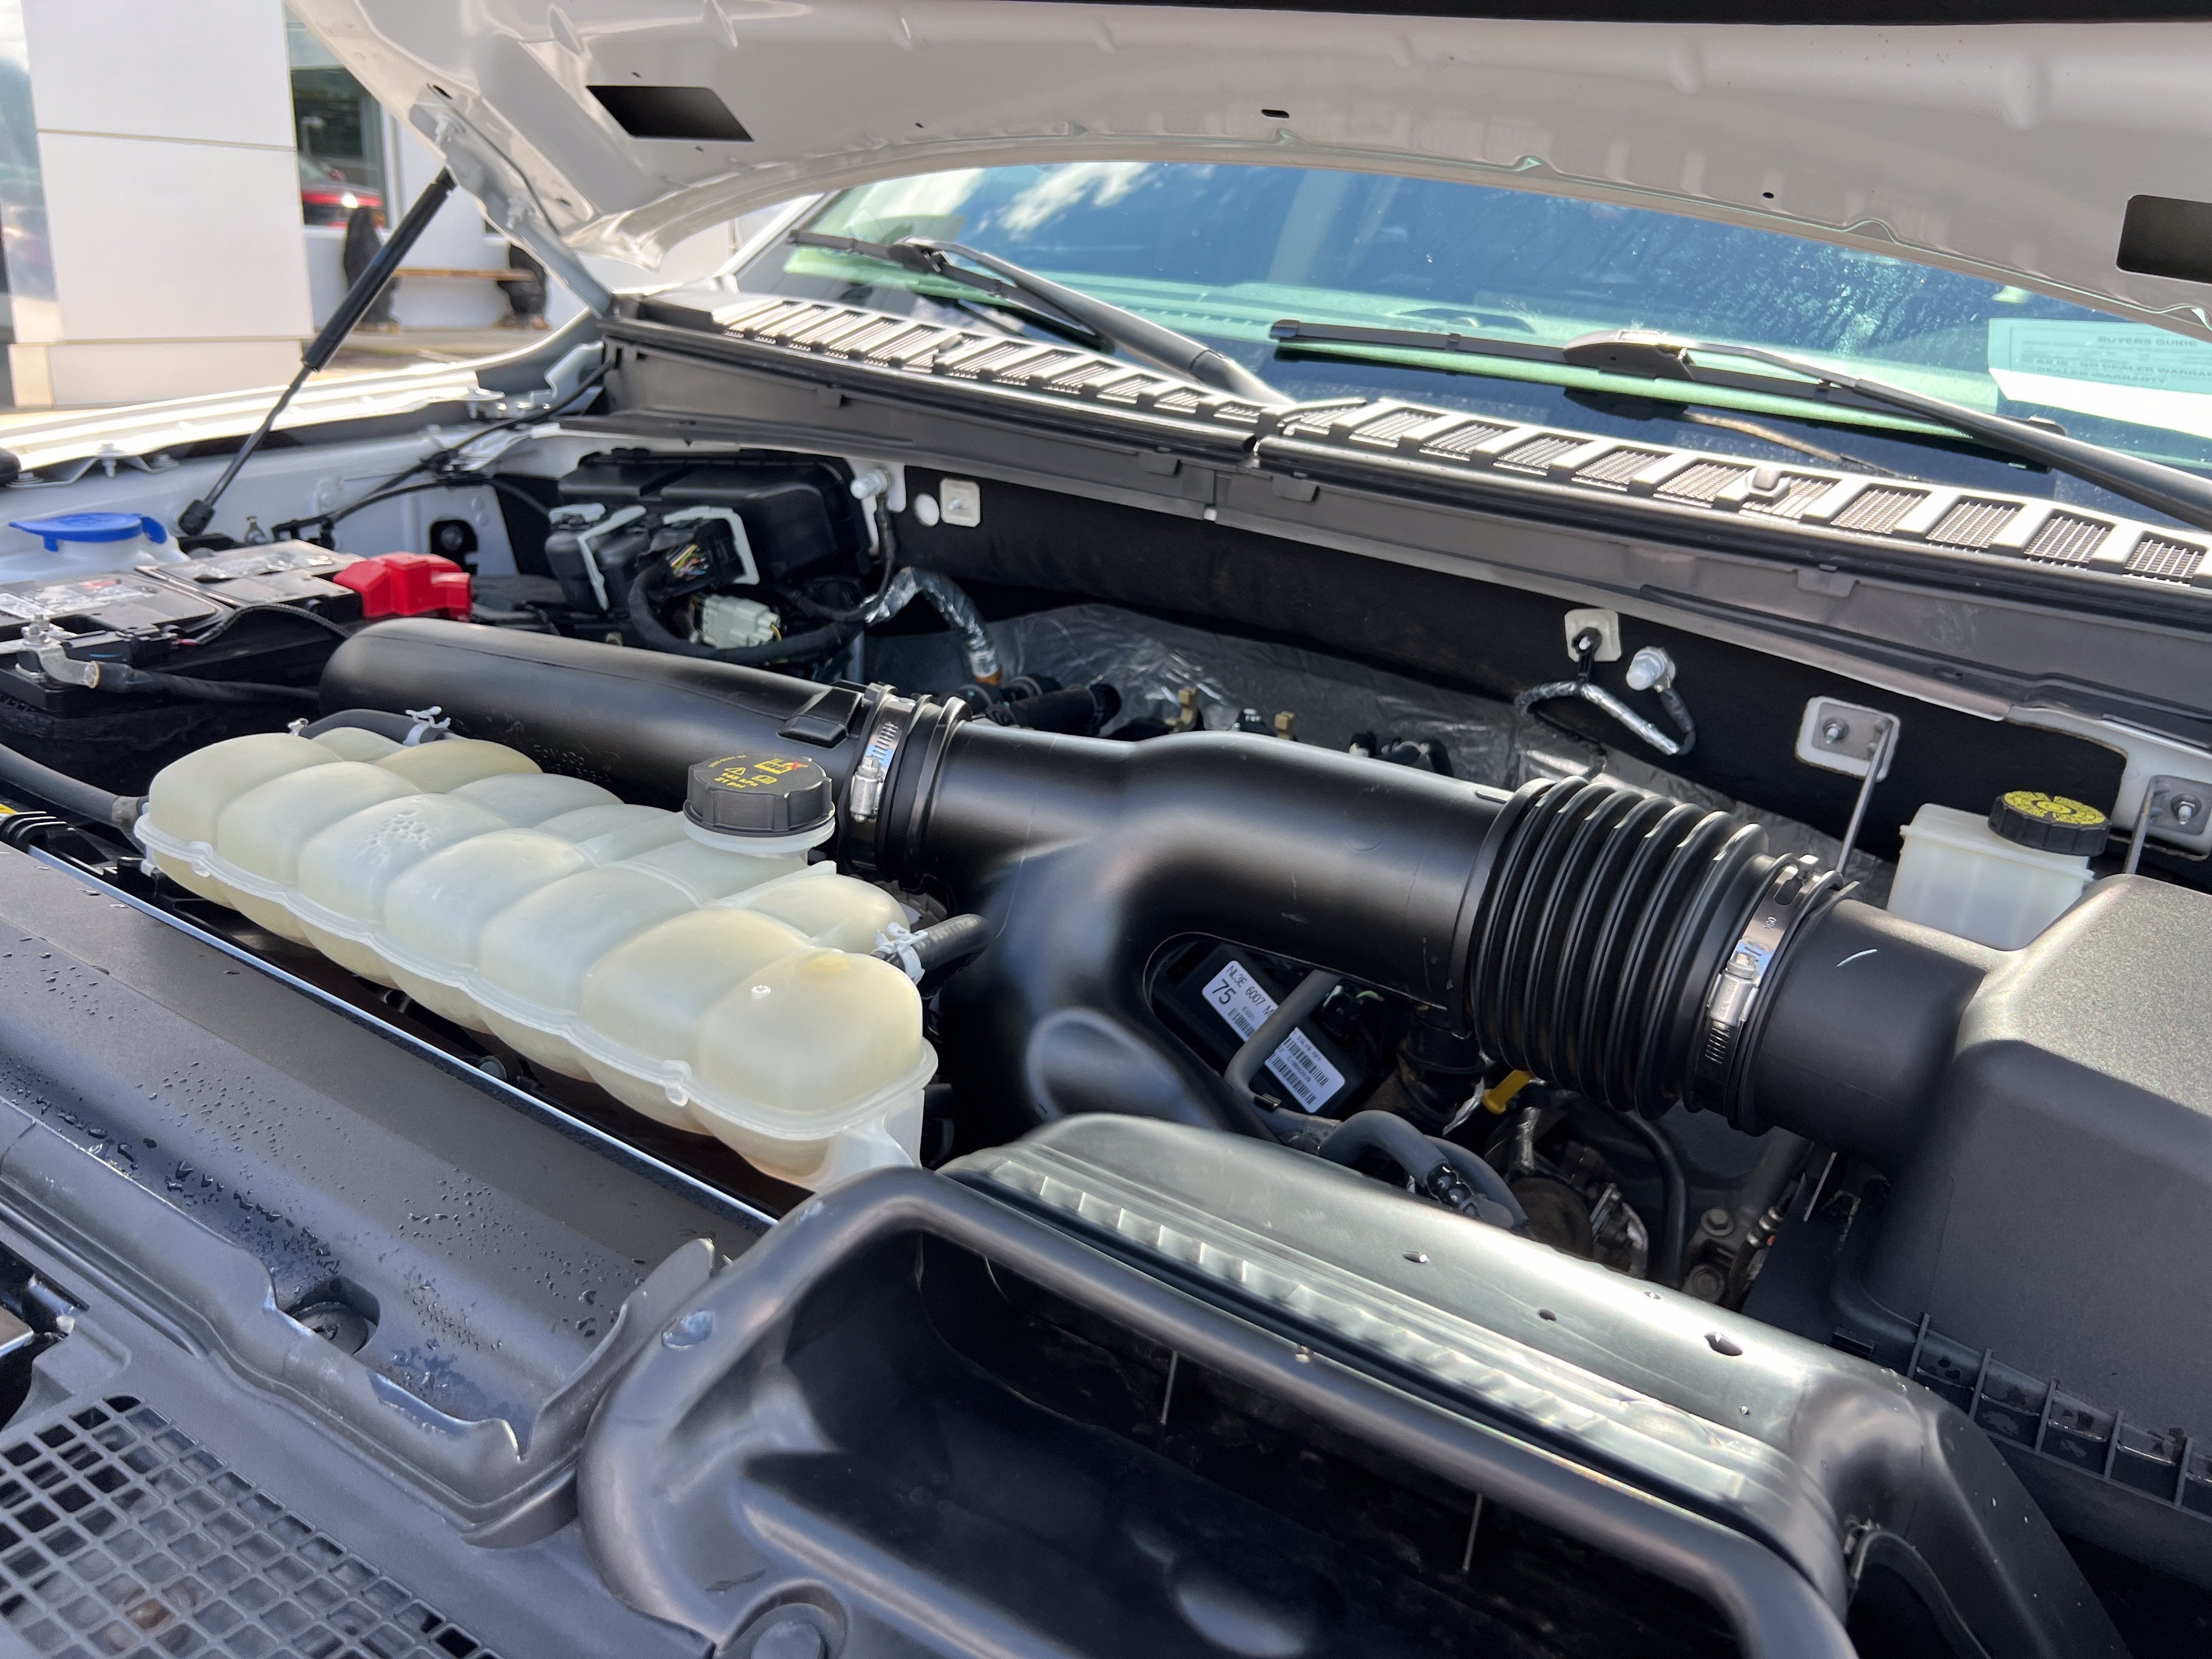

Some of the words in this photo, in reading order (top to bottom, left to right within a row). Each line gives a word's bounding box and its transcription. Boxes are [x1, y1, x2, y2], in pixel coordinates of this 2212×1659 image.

[2097, 336, 2151, 345] BUYERS
[2155, 338, 2197, 347] GUIDE
[1211, 978, 1237, 1005] 75
[1226, 966, 1248, 988] NL3E
[1244, 986, 1266, 1006] 6007
